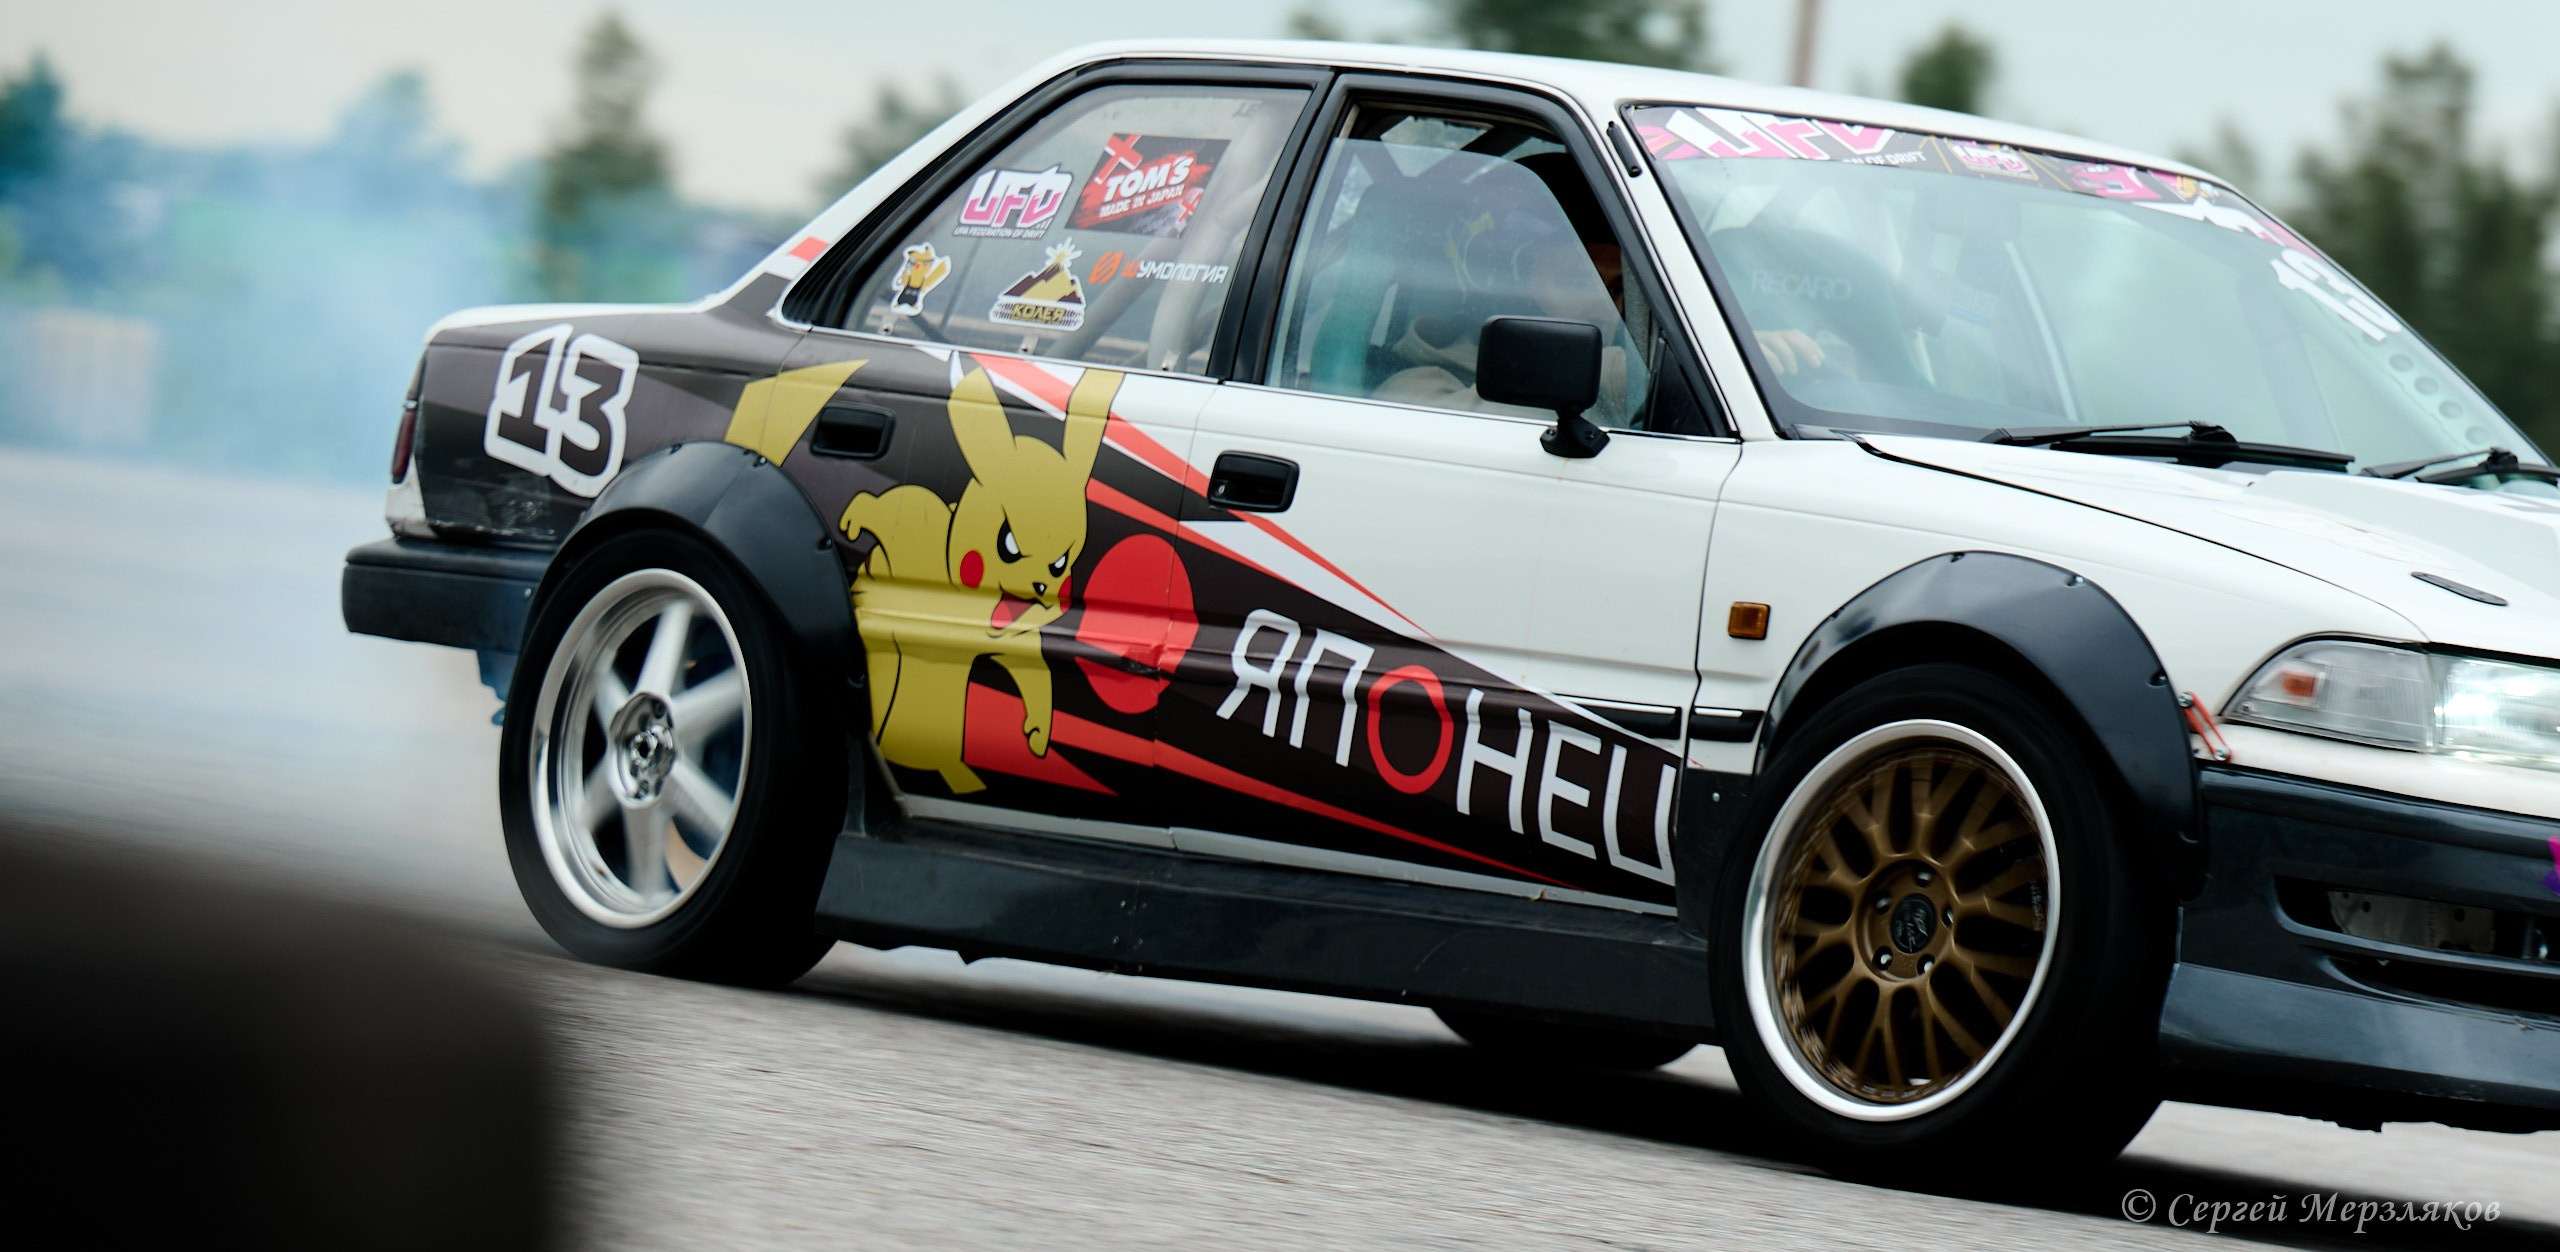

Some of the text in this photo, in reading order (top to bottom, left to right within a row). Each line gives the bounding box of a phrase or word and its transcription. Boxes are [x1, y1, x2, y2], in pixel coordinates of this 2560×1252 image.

[1884, 150, 1927, 165] DRIFT
[959, 165, 1073, 228] UFD
[1099, 184, 1186, 218] MADE IN JAPAN
[1121, 260, 1229, 283] ШУМОЛОГИЯ
[1750, 270, 1854, 300] RECARO
[2270, 248, 2401, 342] 13
[1011, 303, 1065, 322] КОЛЕЯ
[484, 323, 640, 498] 13
